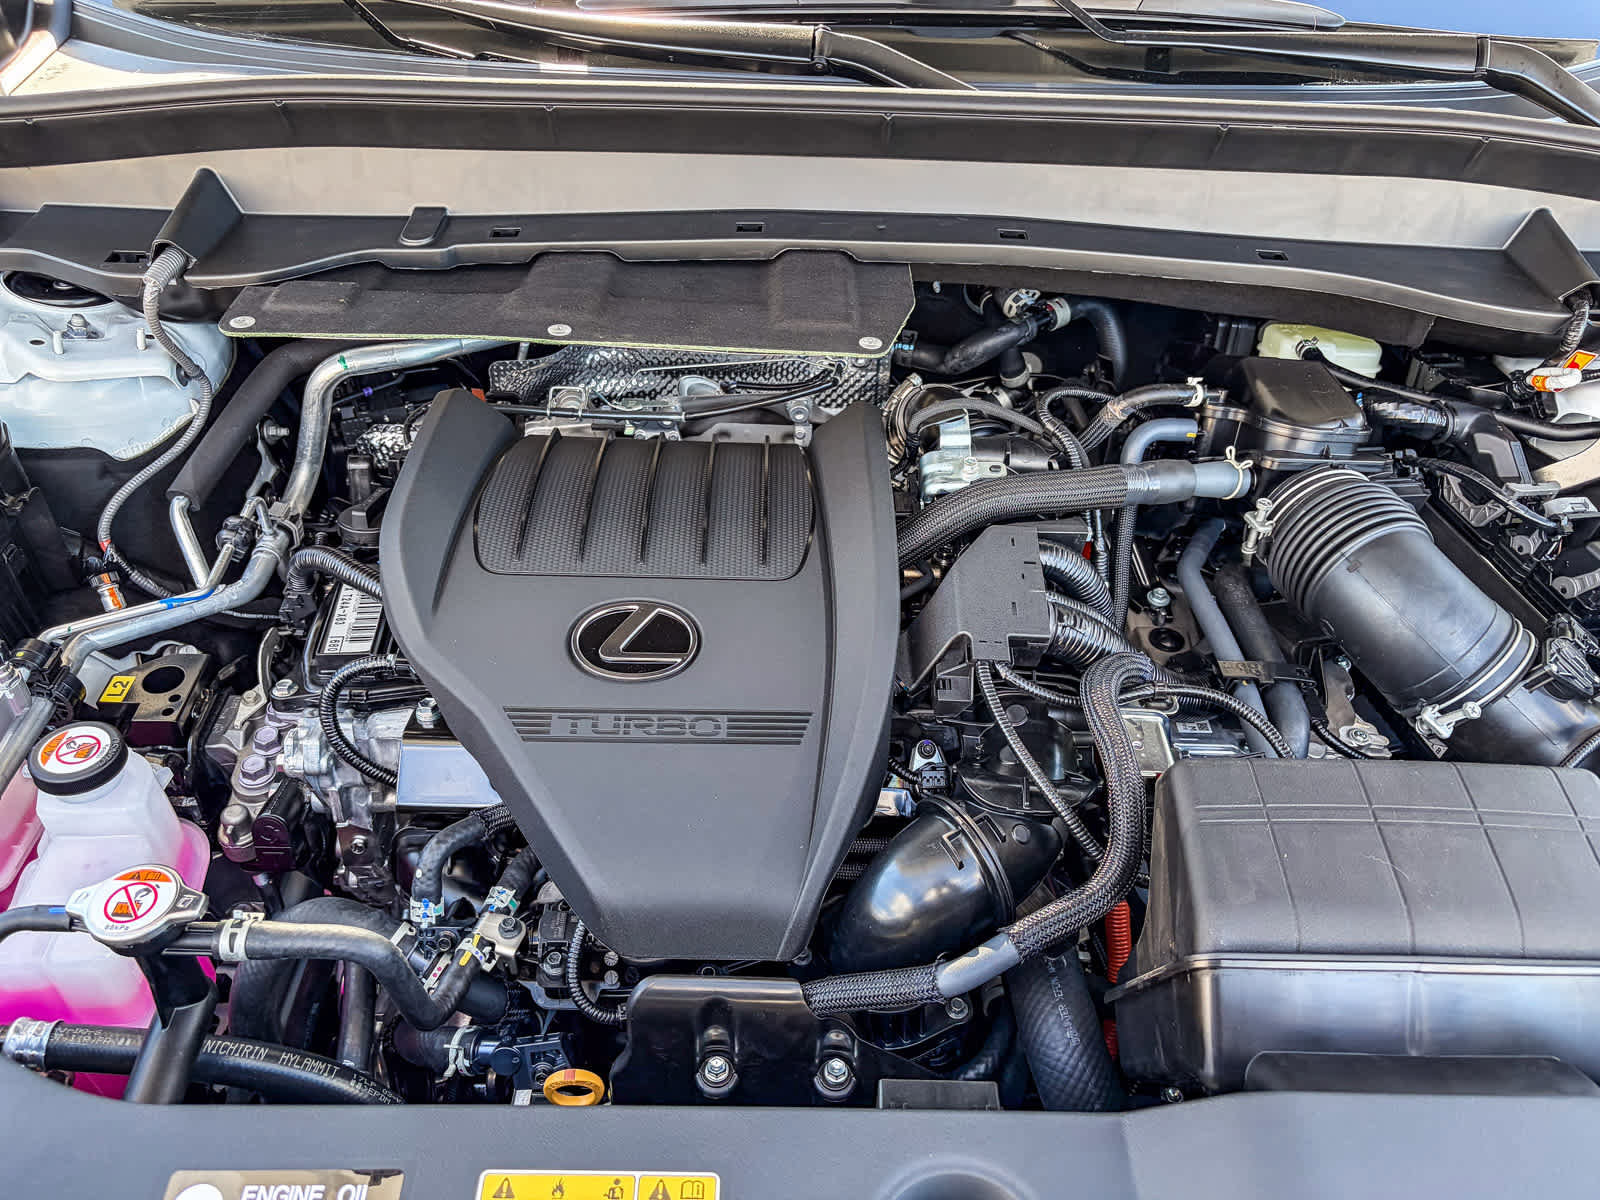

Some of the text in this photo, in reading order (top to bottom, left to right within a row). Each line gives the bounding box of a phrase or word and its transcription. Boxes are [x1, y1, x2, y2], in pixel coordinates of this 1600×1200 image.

[106, 681, 130, 697] L2
[554, 713, 723, 738] TURBO
[203, 1039, 341, 1079] NICHIRIN HYLAMMIT
[240, 1184, 326, 1200] ENGINE
